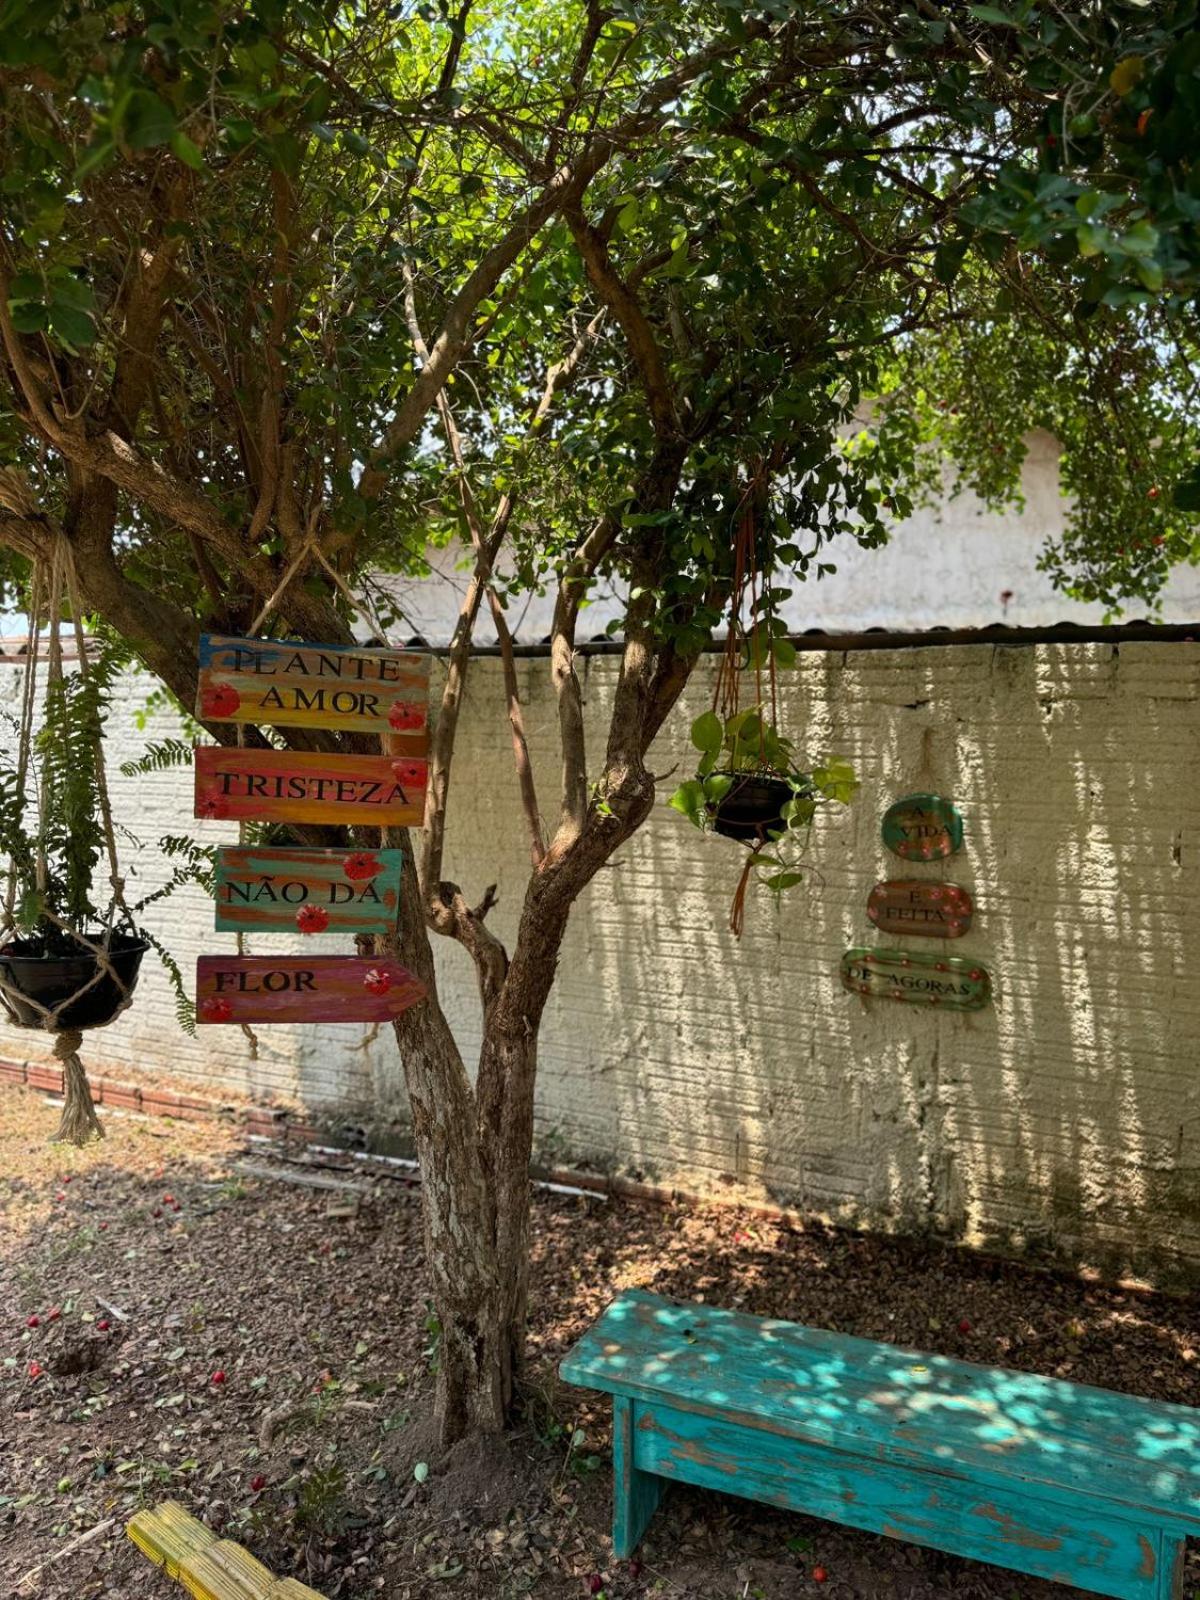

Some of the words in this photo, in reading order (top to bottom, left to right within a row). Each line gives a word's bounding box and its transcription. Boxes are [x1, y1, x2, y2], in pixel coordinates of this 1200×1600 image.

[232, 648, 400, 682] PLANTE
[259, 686, 381, 717] AMOR
[215, 771, 410, 805] TRISTEZA
[911, 806, 924, 818] A
[899, 824, 953, 838] VIDA
[225, 875, 309, 904] NÃO
[328, 877, 384, 905] DÁ
[886, 907, 945, 922] FEITA
[214, 970, 319, 993] FLOR
[847, 966, 873, 981] DE
[887, 973, 971, 996] AGORAS
